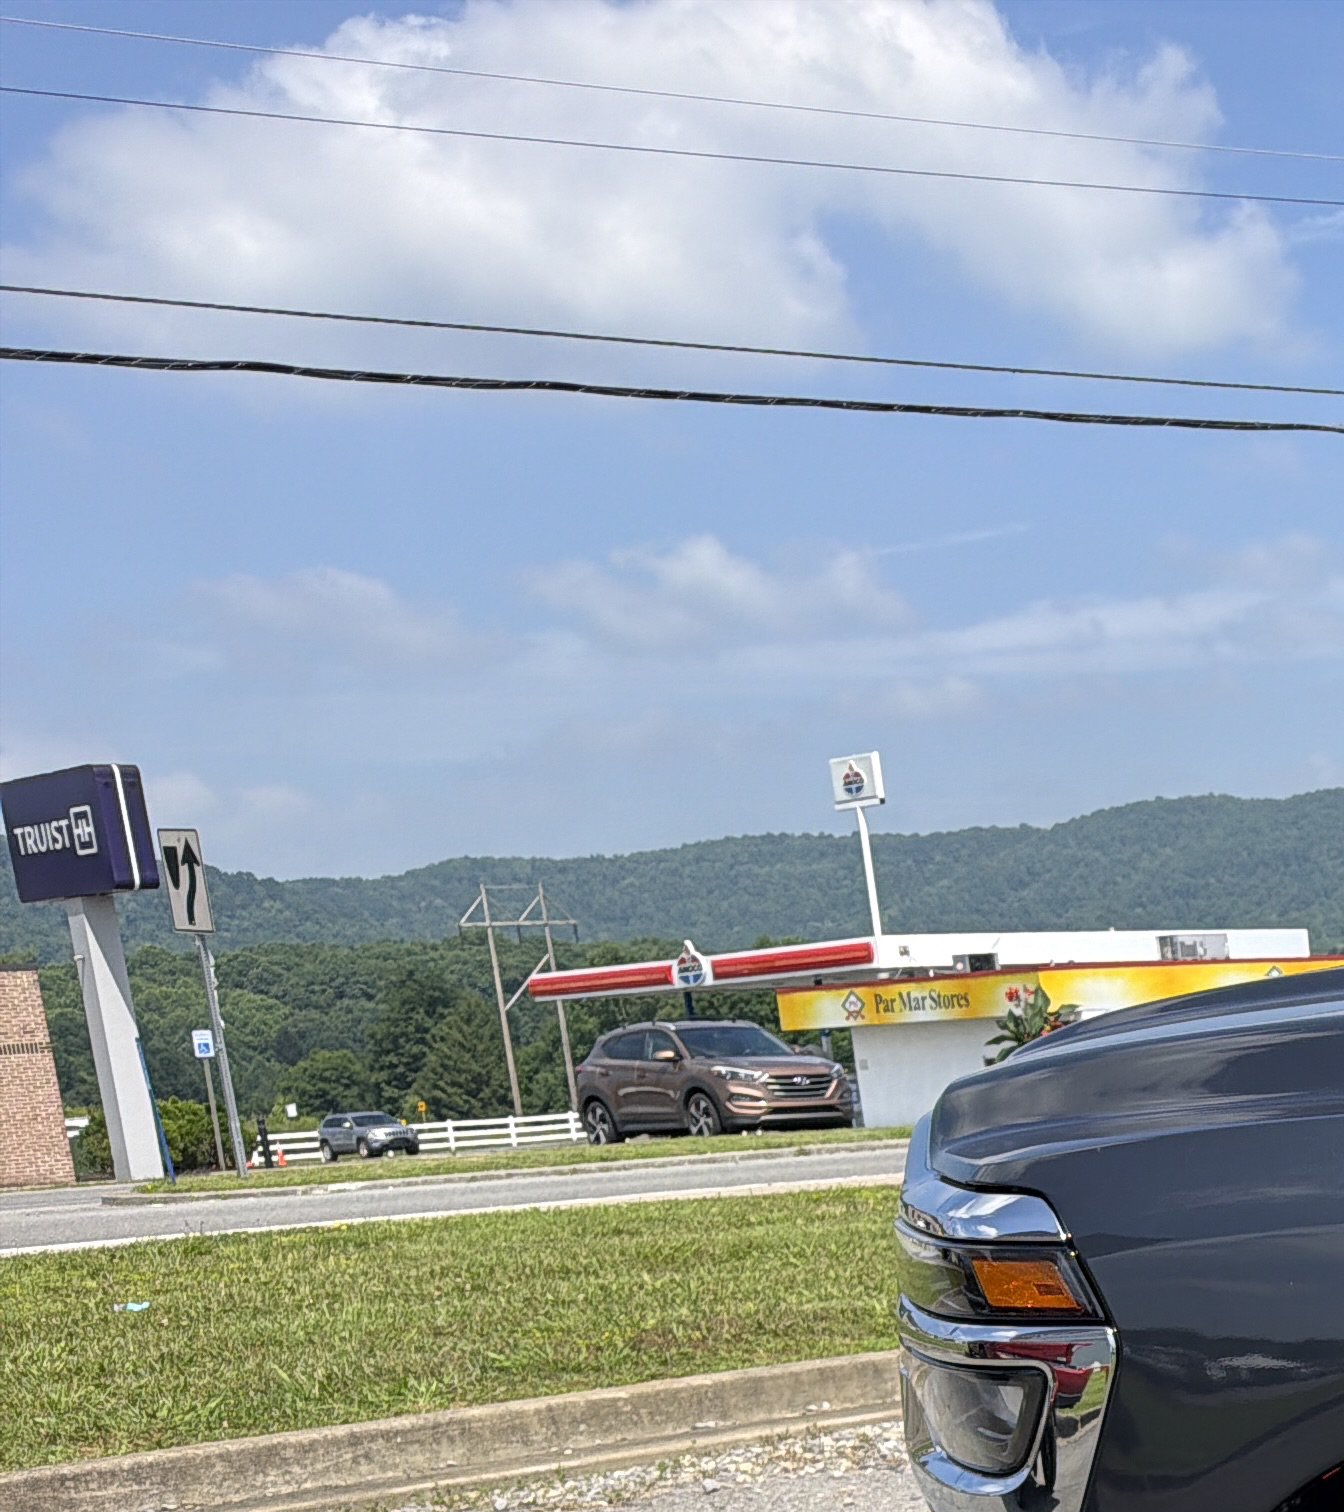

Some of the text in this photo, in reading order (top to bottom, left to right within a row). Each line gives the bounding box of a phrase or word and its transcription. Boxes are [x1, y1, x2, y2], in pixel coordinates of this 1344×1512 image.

[13, 819, 70, 855] TRUIST
[873, 993, 896, 1014] Par
[898, 991, 928, 1012] Mar
[928, 989, 970, 1010] Stores
